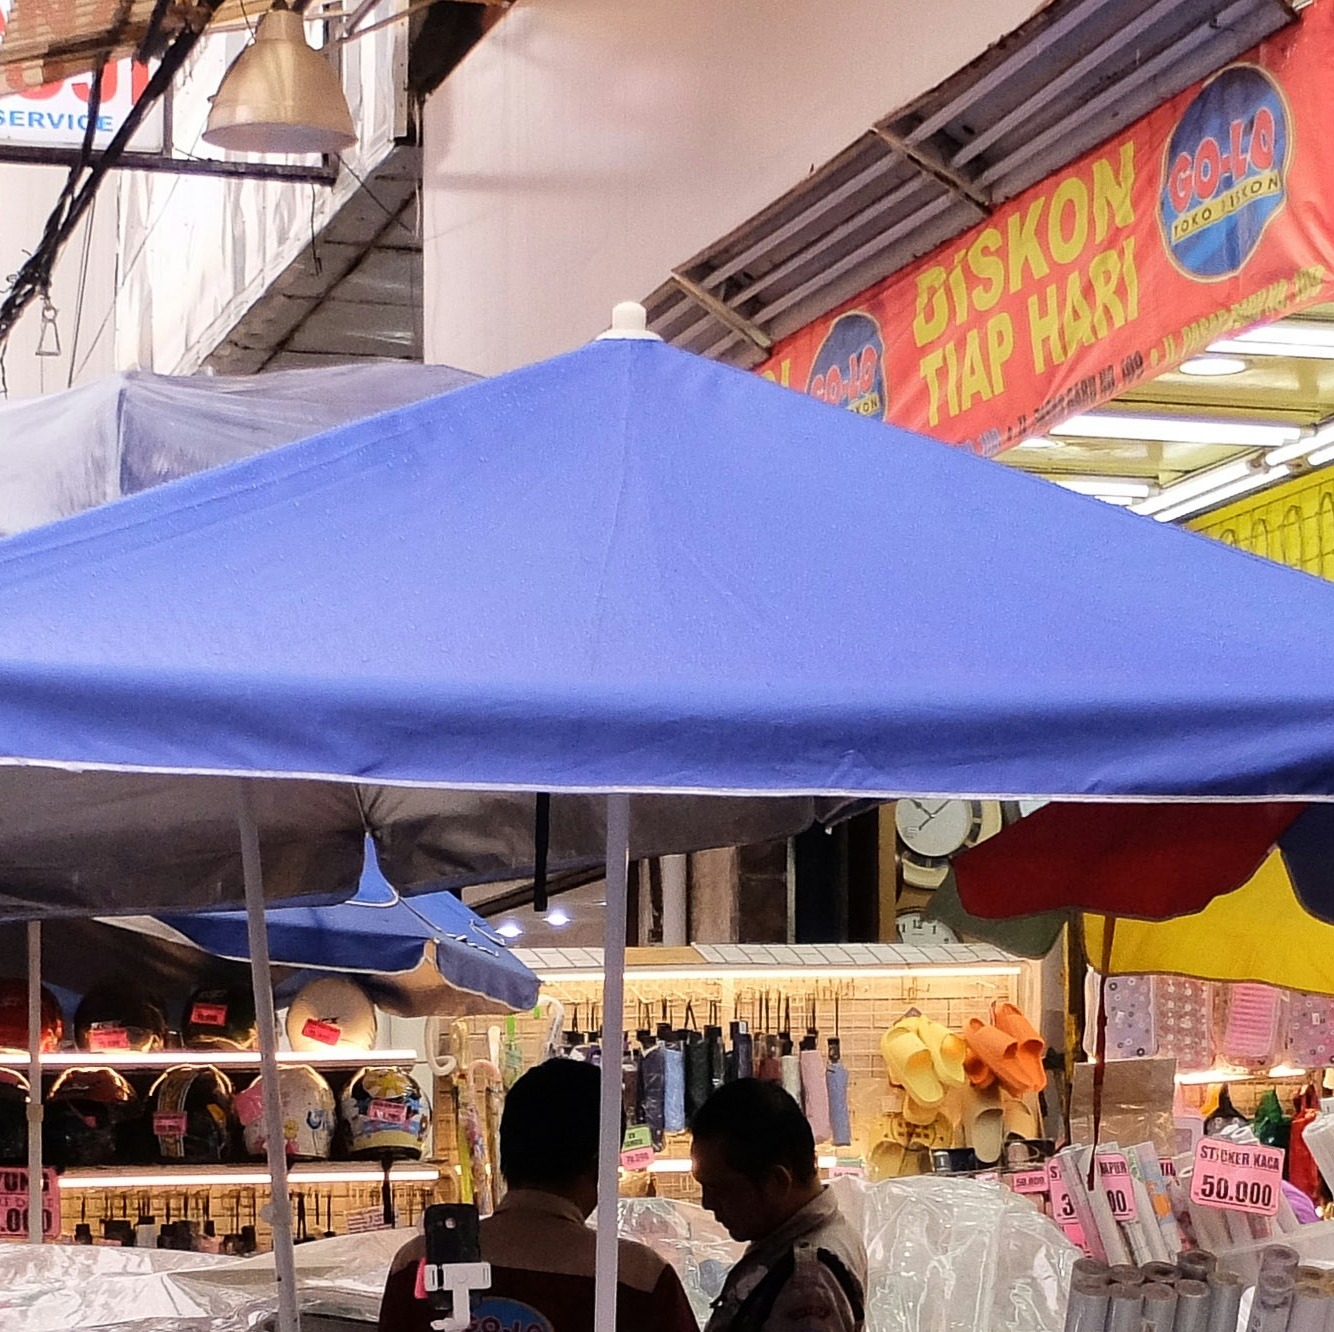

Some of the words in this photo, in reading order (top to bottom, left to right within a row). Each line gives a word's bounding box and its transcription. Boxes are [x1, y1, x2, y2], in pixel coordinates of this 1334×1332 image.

[1169, 106, 1276, 215] GO-LO
[912, 140, 1138, 348] DISKON
[1173, 206, 1212, 237] TOKO
[919, 326, 1015, 428] TIAP
[1029, 236, 1140, 373] HARI
[1200, 1145, 1250, 1167] STICKER
[1253, 1152, 1280, 1171] KACA
[1200, 1174, 1273, 1208] 50.000
